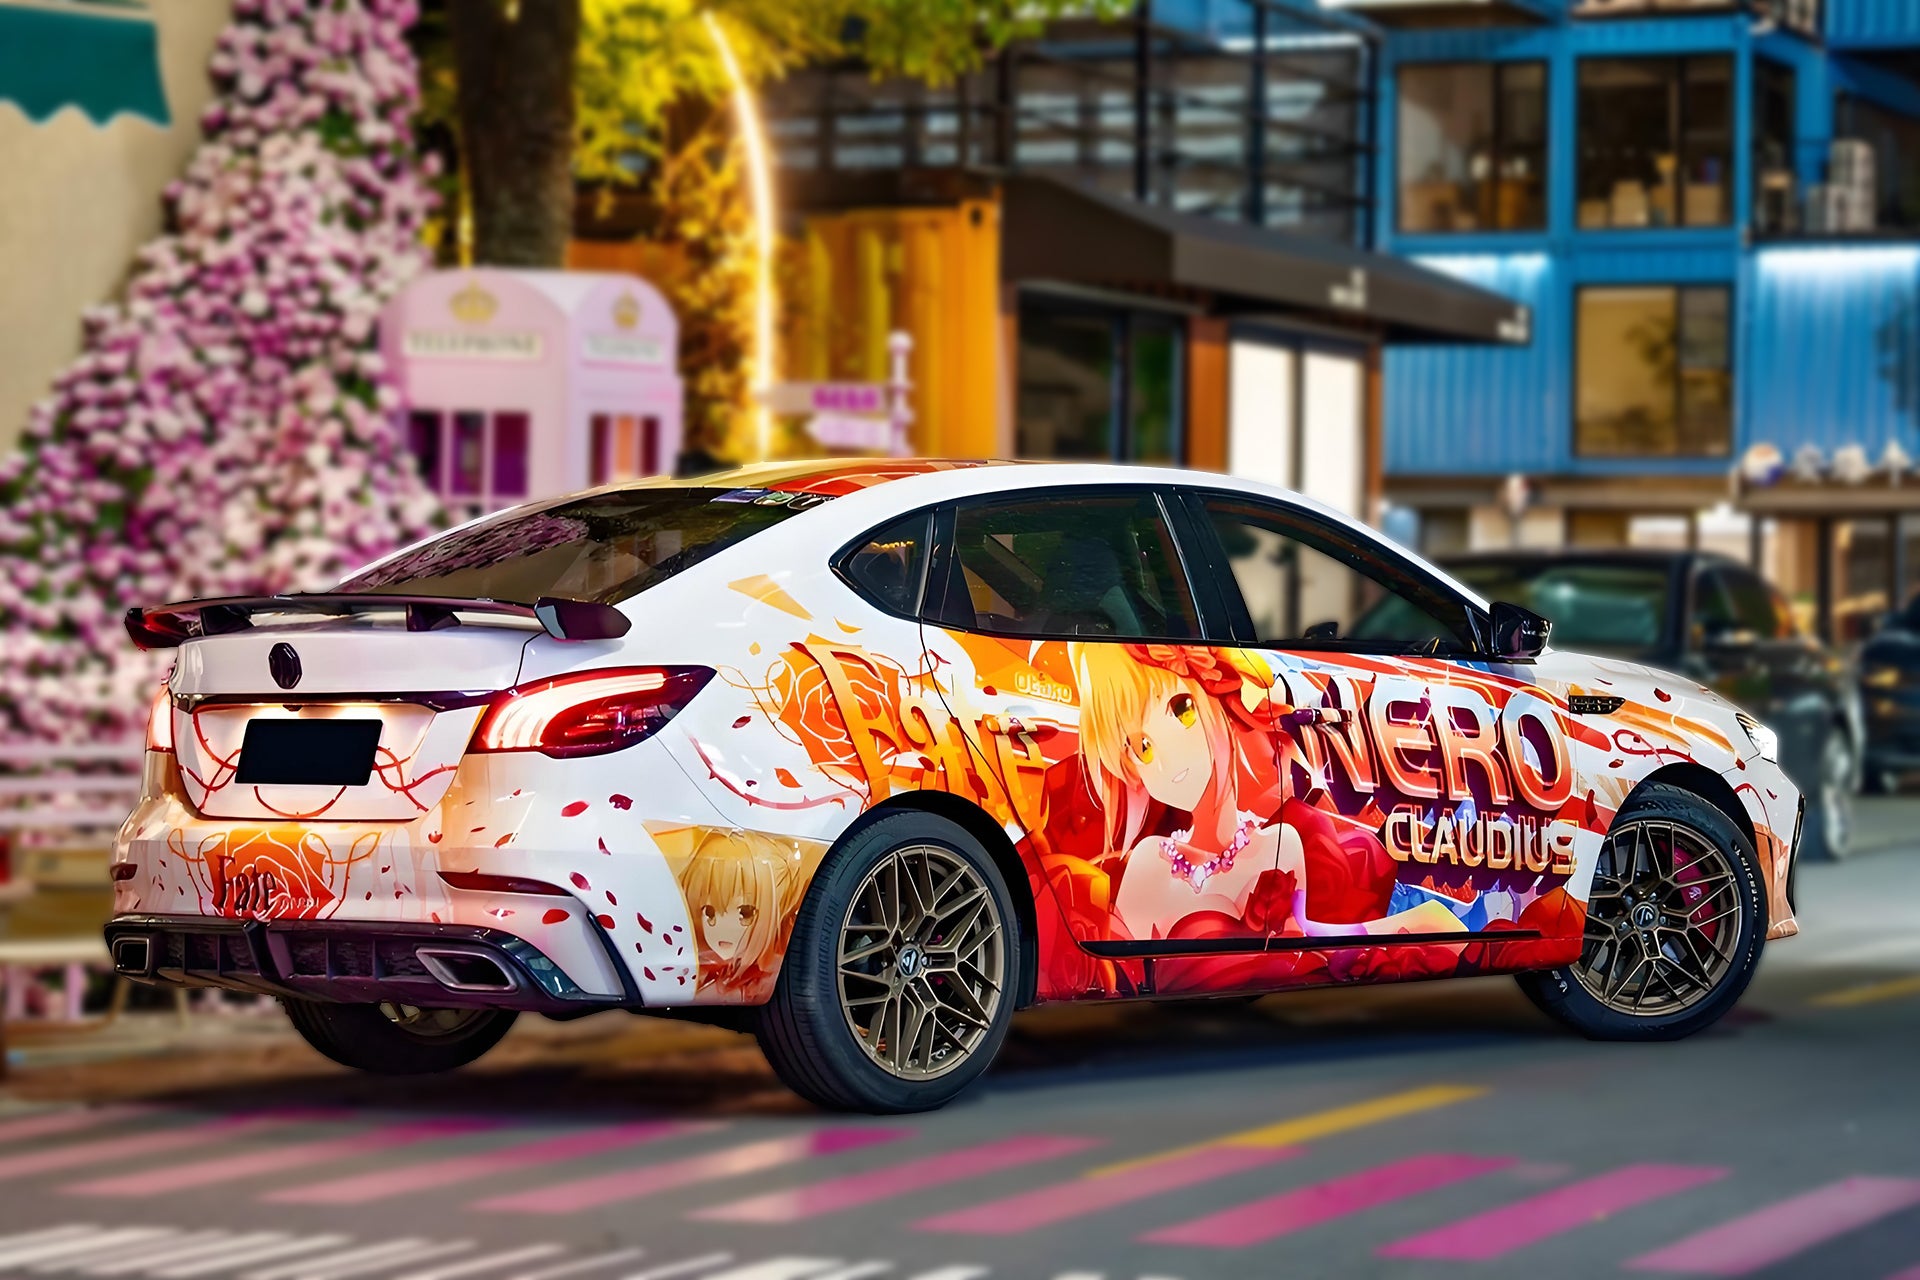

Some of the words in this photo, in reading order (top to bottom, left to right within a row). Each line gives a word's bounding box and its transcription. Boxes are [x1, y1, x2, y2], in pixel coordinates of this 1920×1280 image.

[1278, 672, 1573, 812] NERO
[1385, 805, 1579, 875] CLAUDIUS
[215, 855, 278, 914] Fate
